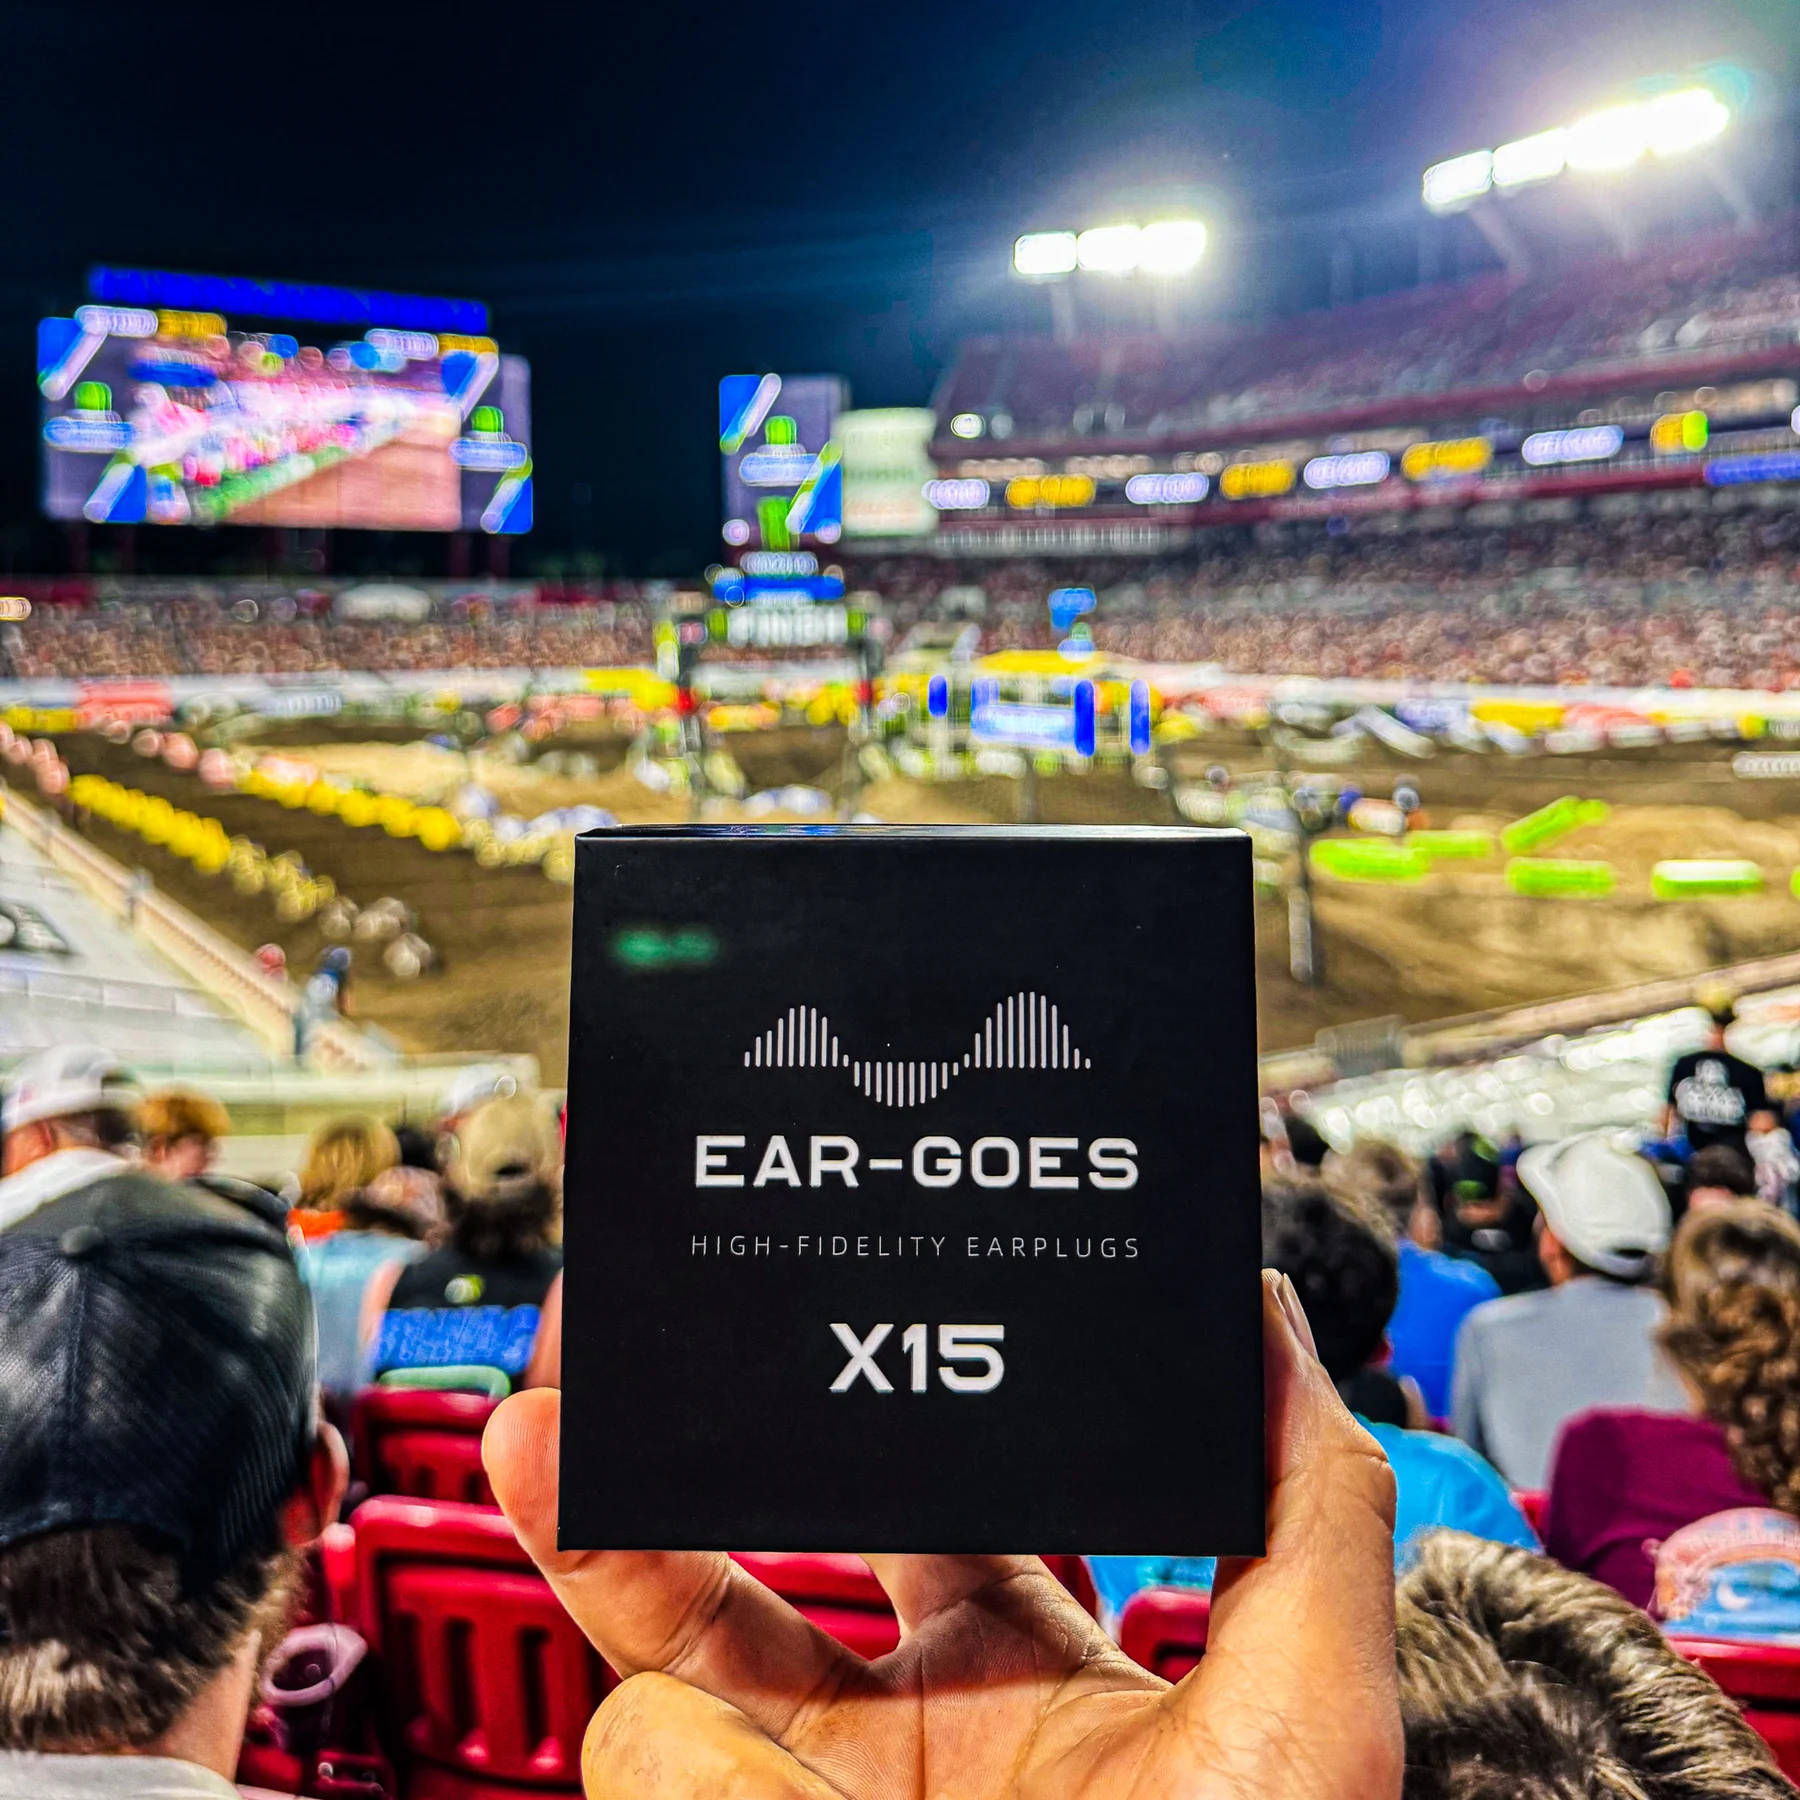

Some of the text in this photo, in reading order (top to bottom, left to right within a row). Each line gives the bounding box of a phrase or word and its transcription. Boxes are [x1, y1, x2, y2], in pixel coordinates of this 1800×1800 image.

[694, 1134, 1140, 1190] EAR-GOES
[690, 1234, 1140, 1259] HIGH-FIDELITY EARPLUGS
[828, 1322, 1006, 1394] X15
